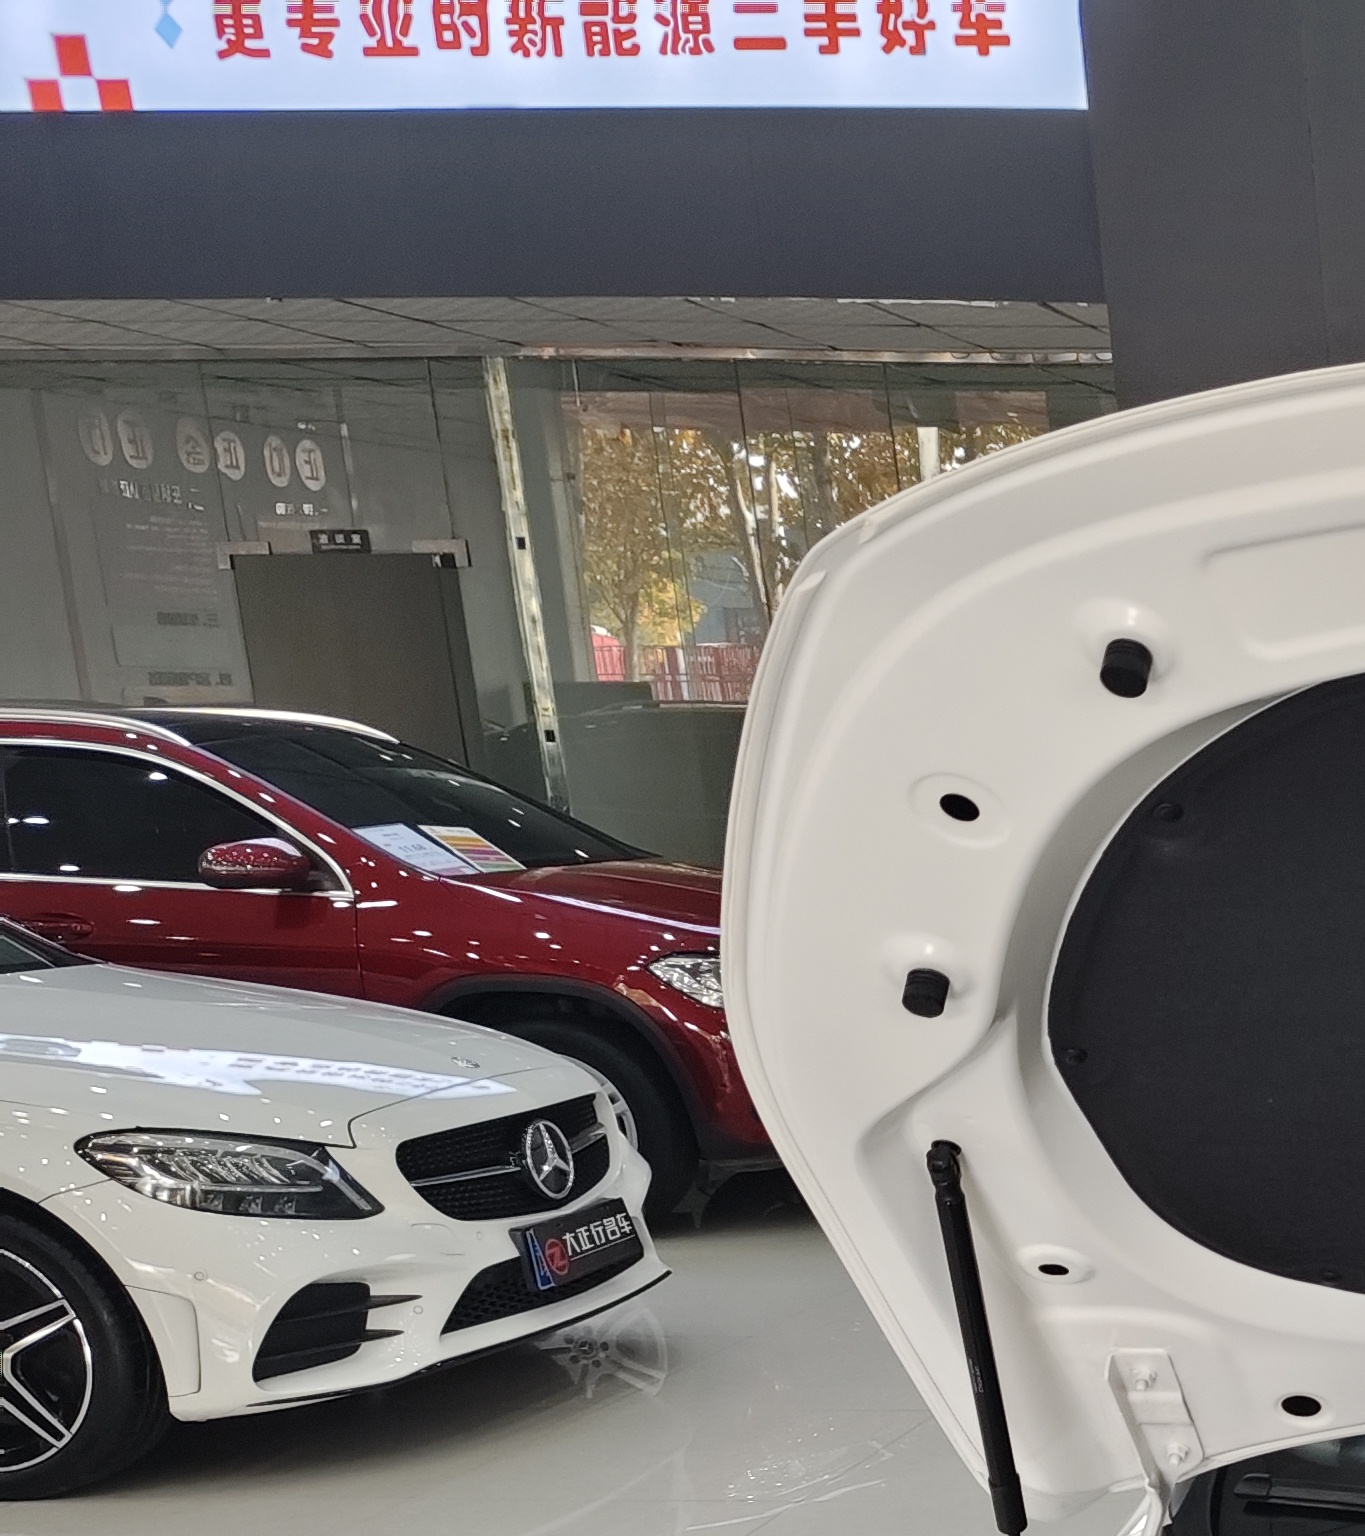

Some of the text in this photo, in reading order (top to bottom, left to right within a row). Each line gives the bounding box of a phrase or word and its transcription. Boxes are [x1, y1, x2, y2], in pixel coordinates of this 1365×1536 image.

[561, 1212, 634, 1257] 大正行名车
